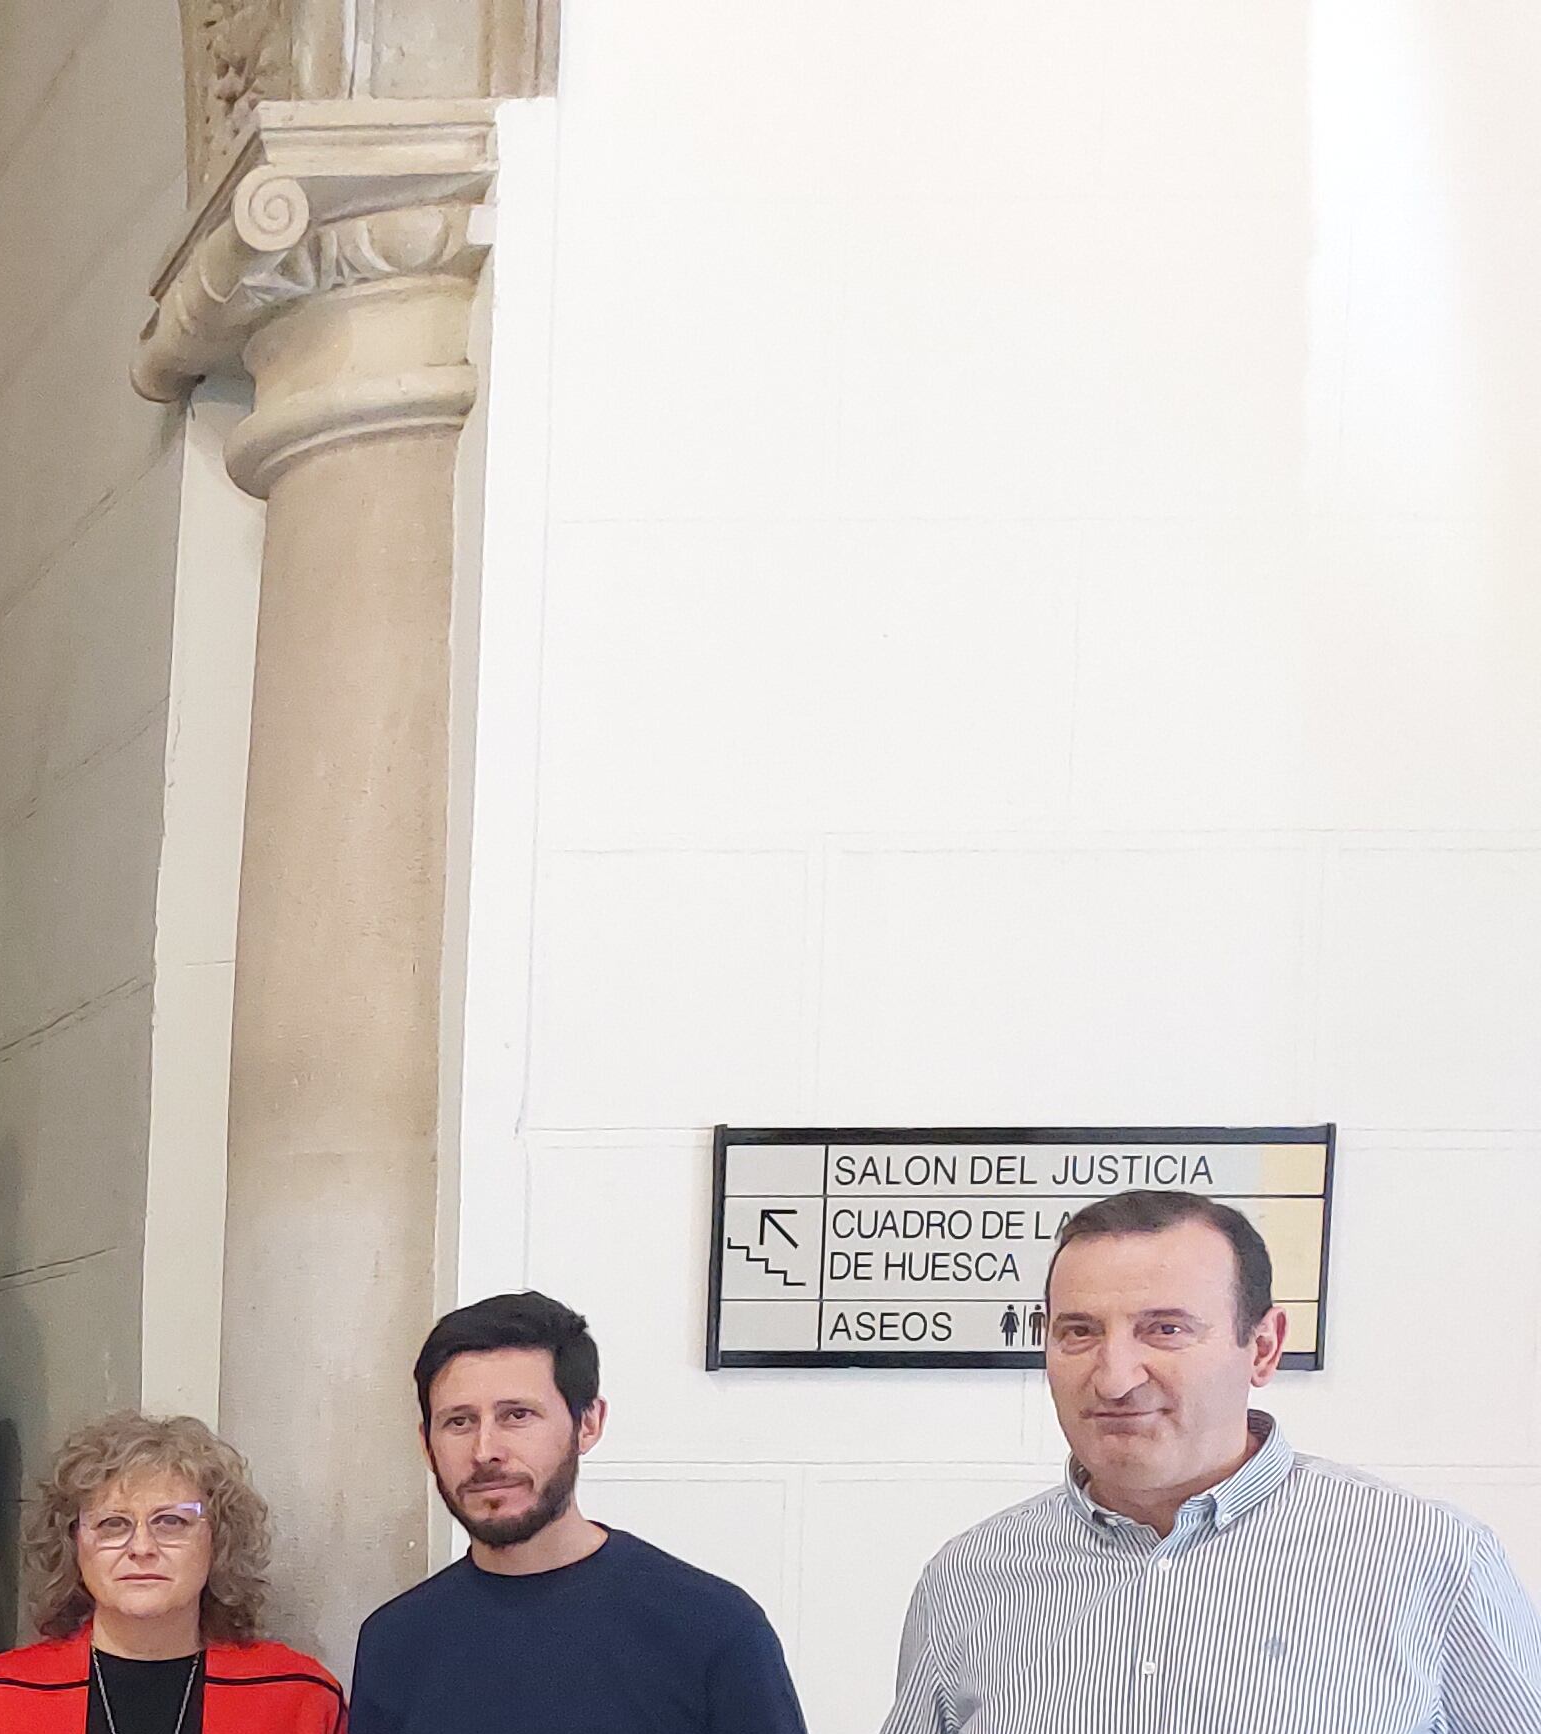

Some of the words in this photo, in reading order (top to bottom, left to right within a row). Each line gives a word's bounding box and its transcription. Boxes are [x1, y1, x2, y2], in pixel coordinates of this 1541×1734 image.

[834, 1155, 957, 1185] SALON
[970, 1155, 1037, 1184] DEL
[1051, 1154, 1213, 1184] JUSTICIA
[832, 1209, 972, 1239] CUADRO
[981, 1210, 1024, 1239] DE
[829, 1251, 873, 1280] DE
[884, 1252, 1020, 1281] HUESCA
[828, 1311, 952, 1341] ASEOS
